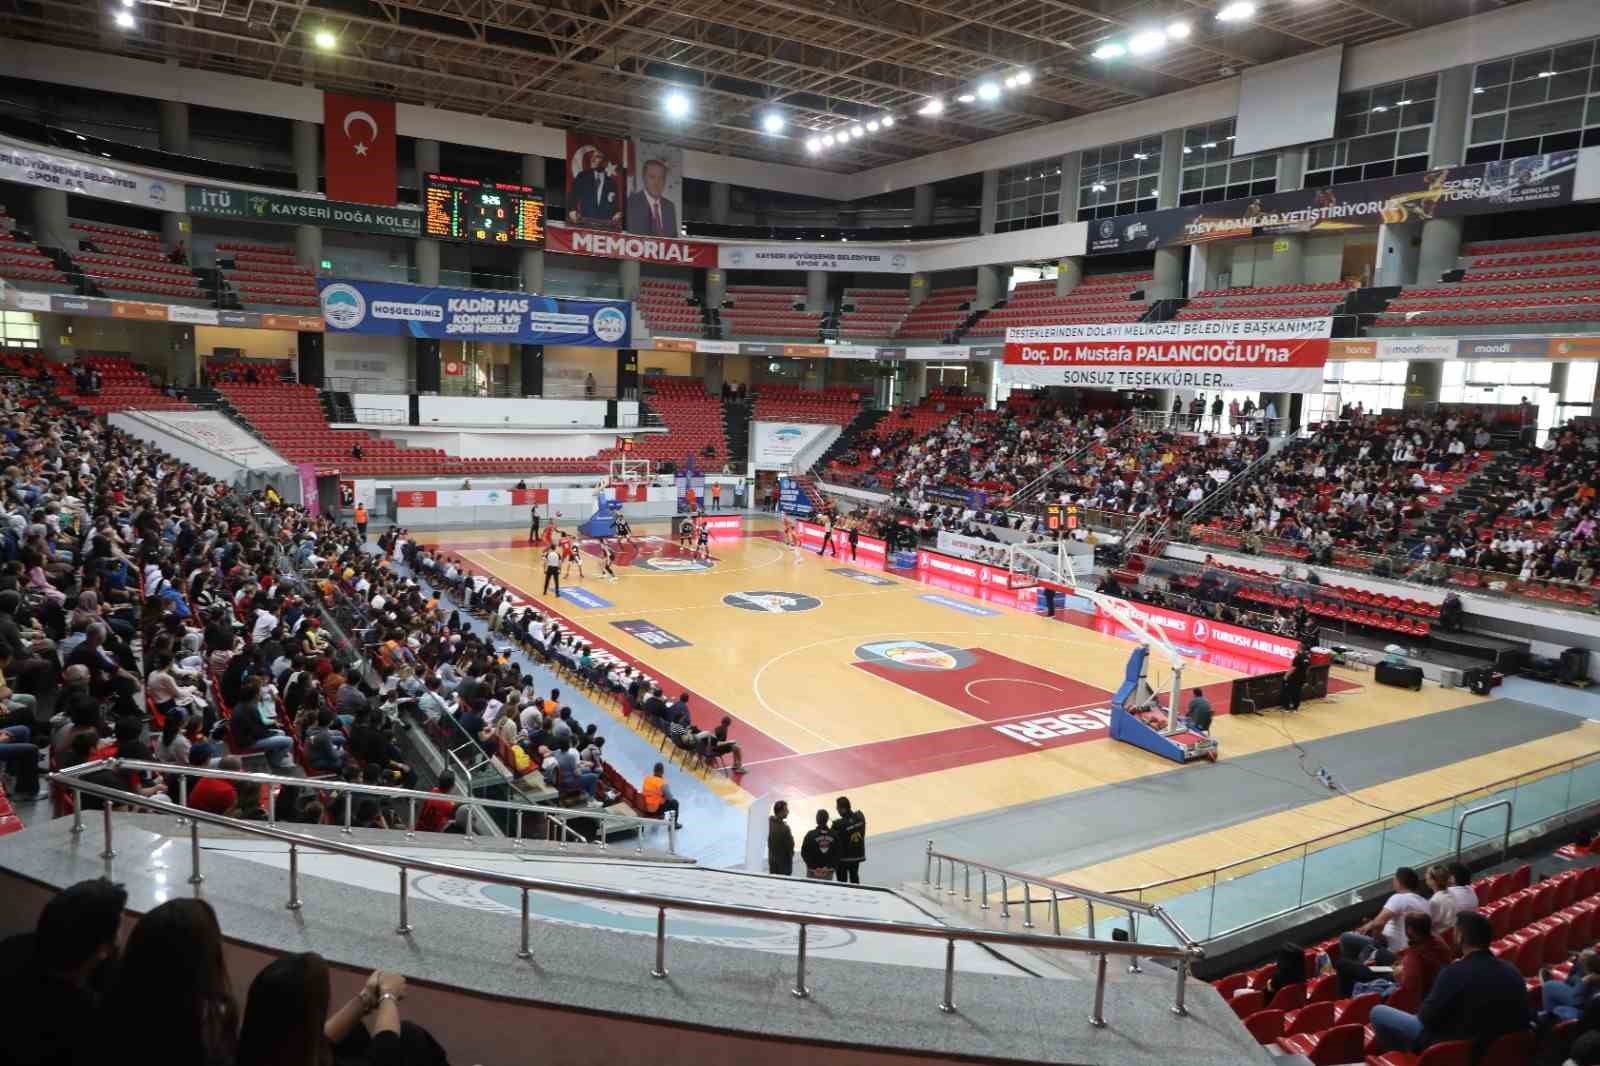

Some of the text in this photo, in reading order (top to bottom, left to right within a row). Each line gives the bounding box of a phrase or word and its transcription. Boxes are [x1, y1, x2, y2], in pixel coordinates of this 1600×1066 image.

[201, 188, 231, 207] İTÜ
[271, 202, 421, 230] KAYSERİ DOĞA KOLEJİ
[571, 232, 696, 264] MEMORIAL
[447, 297, 529, 313] KADİR HAS
[452, 313, 503, 324] KONGRE
[1183, 322, 1240, 336] BELEDİYE
[1243, 319, 1326, 336] BAŞKANIMIZ
[1022, 340, 1290, 365] Doç. Dr. Mustafa PALANCIOĞLU'na
[1345, 345, 1372, 354] home
[1474, 343, 1511, 354] mondi
[1064, 369, 1234, 388] SONSUZ TEŞEKKÜRLER...
[1211, 628, 1296, 658] TURKISH AIRLINES
